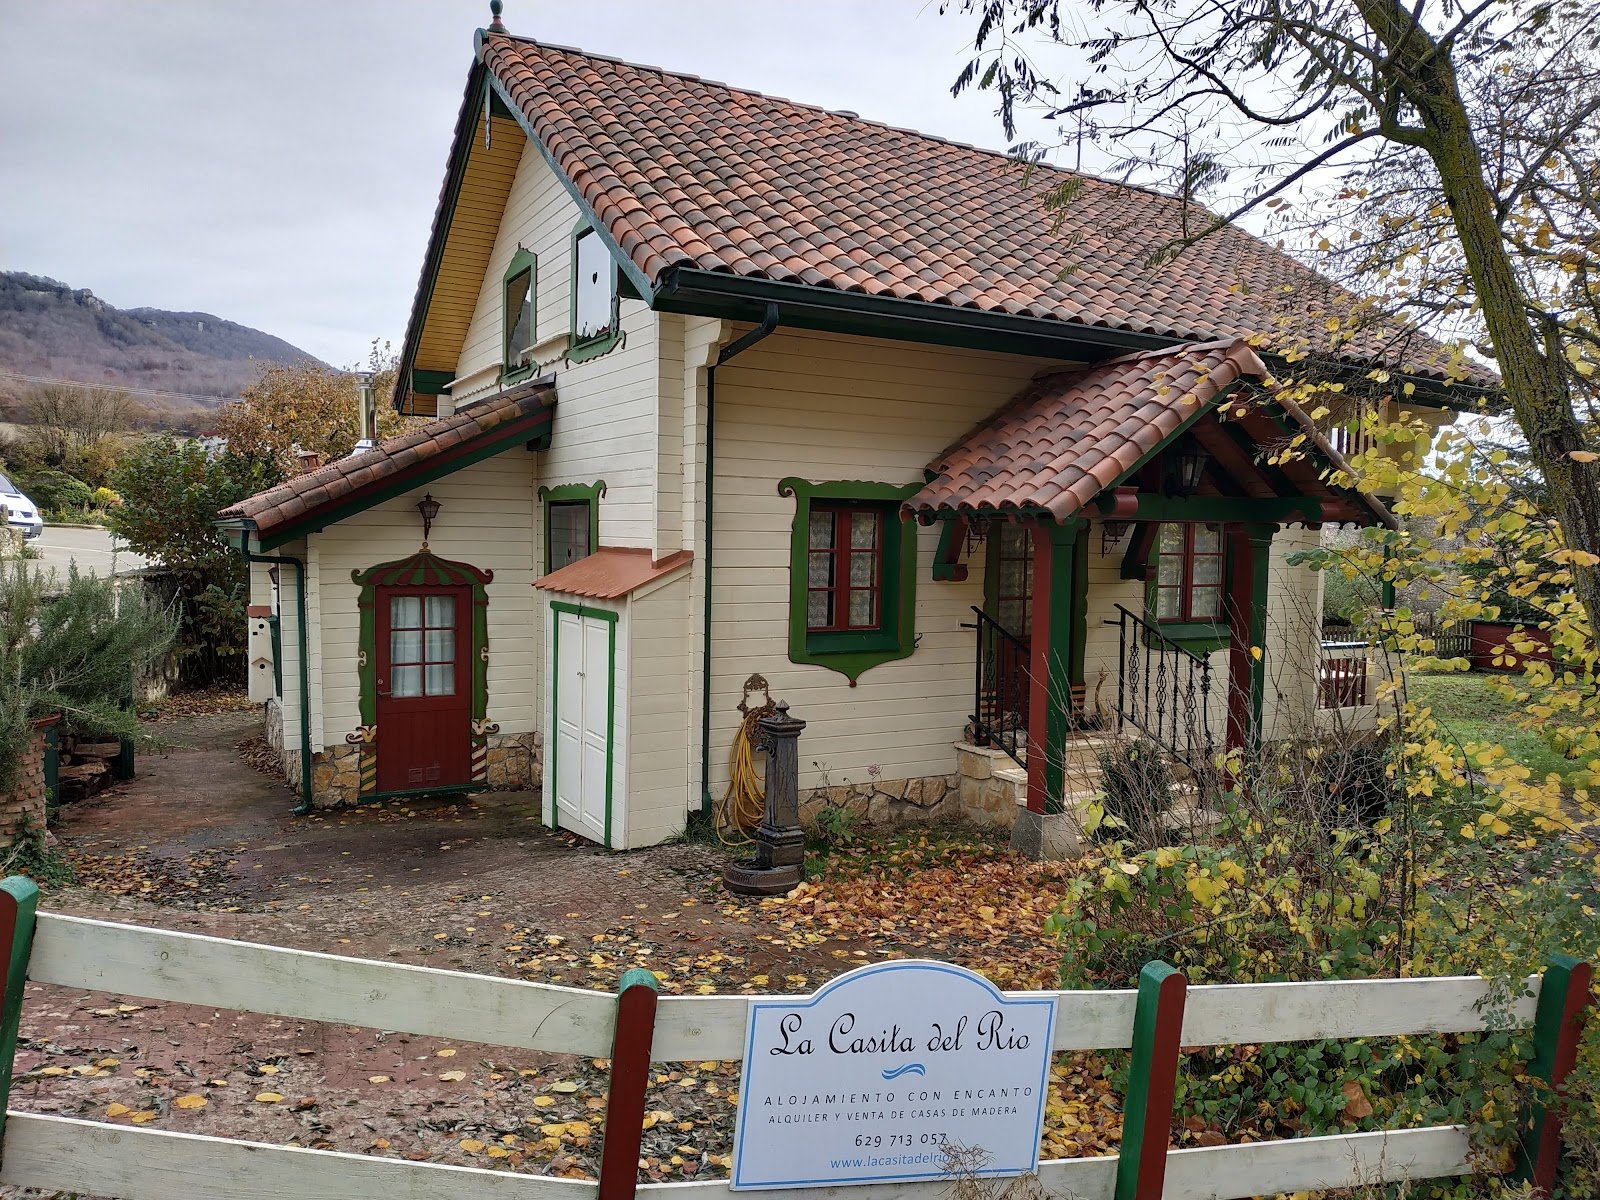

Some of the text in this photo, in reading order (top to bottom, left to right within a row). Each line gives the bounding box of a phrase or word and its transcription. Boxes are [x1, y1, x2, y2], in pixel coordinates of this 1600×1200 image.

[770, 1010, 1030, 1056] La Casita del Rio
[764, 1087, 1032, 1106] ALOJAMIENTO CON ENCANTO
[768, 1106, 1017, 1124] ALQUILER Y VENTA DE CASAS DE MADERA
[855, 1132, 947, 1148] 629 713 057
